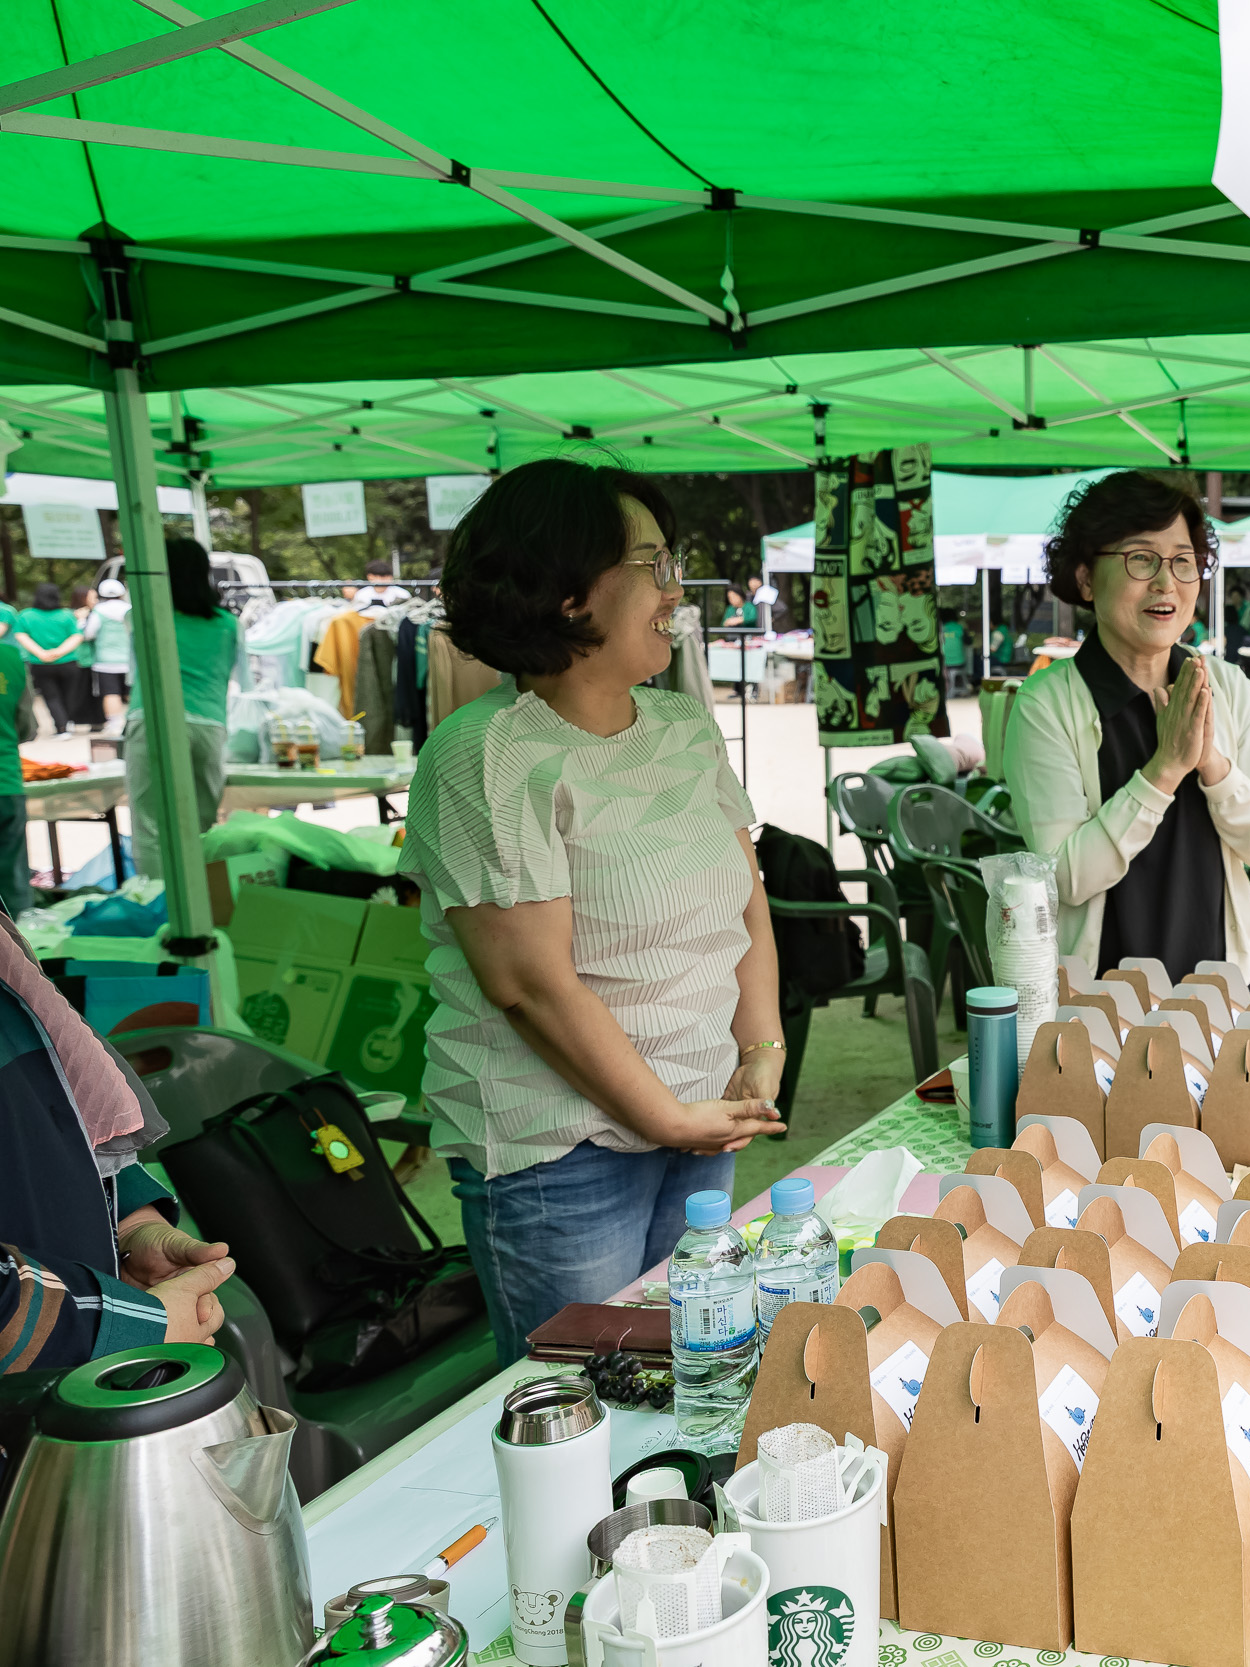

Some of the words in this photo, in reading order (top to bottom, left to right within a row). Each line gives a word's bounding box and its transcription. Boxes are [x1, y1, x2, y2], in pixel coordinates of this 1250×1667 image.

[824, 1283, 833, 1305] 마신
[717, 1304, 729, 1337] 마신다
[547, 1628, 564, 1636] 2018
